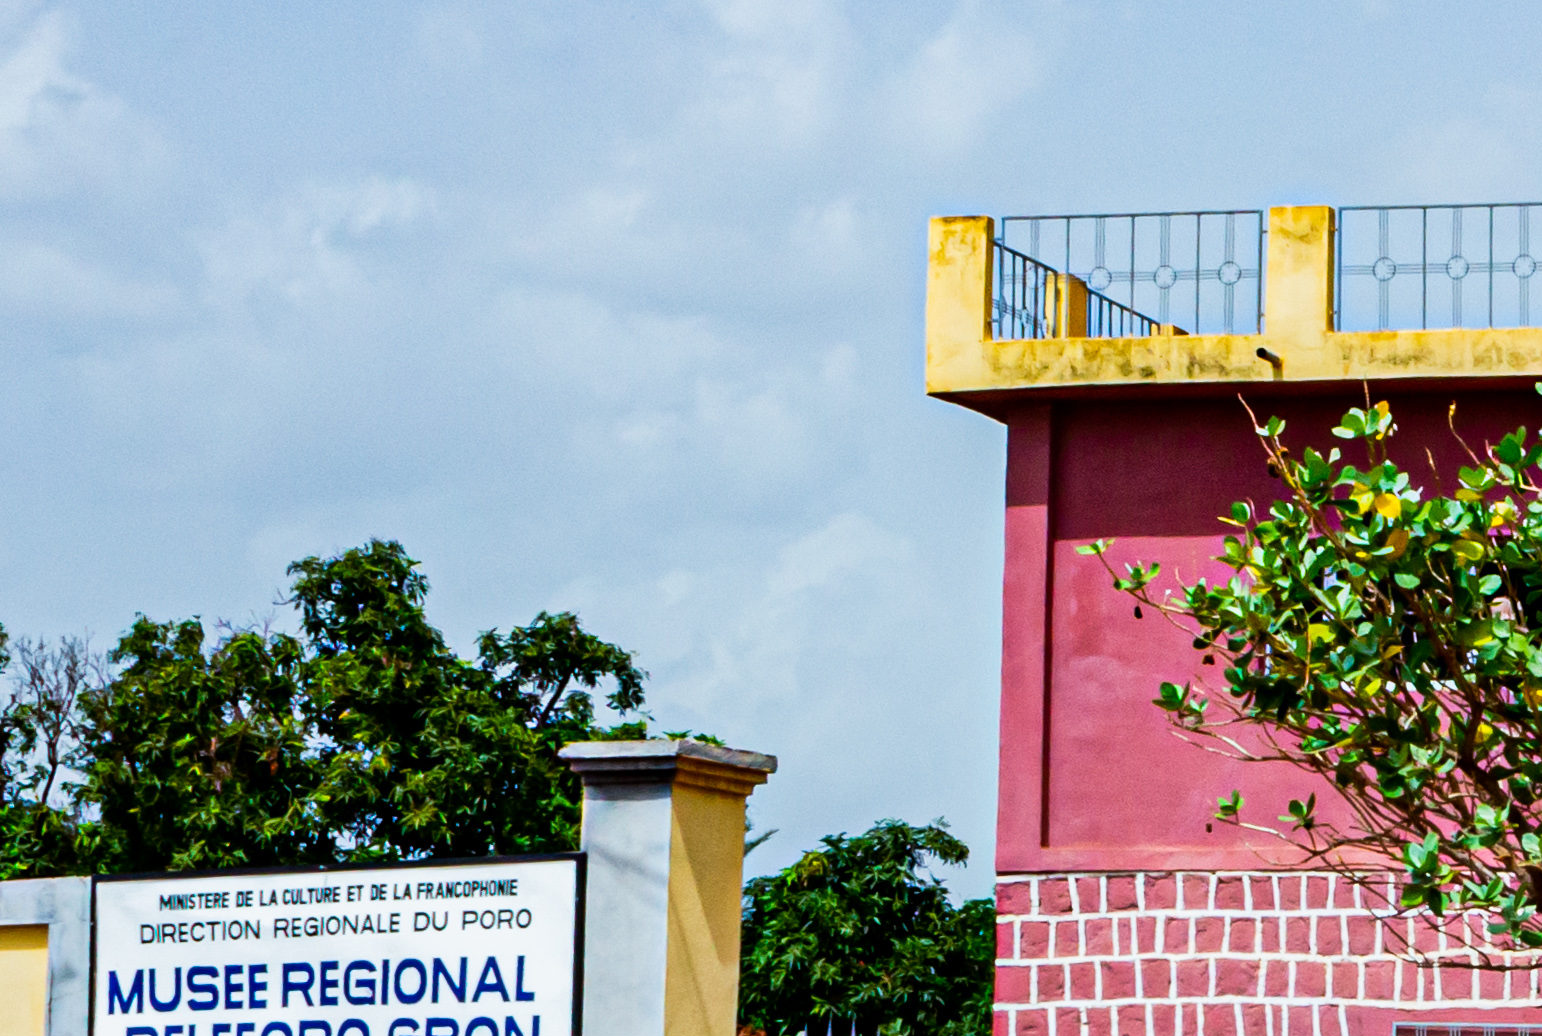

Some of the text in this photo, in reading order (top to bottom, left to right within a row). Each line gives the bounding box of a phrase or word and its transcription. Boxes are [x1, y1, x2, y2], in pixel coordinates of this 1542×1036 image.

[159, 879, 519, 911] MINISTERE DE LA CULTURE ET DE LA FRANCOPHONIE
[140, 908, 533, 945] DIRECTION REGIONALE DU PORO
[107, 955, 536, 1015] MUSEE REGIONAL
